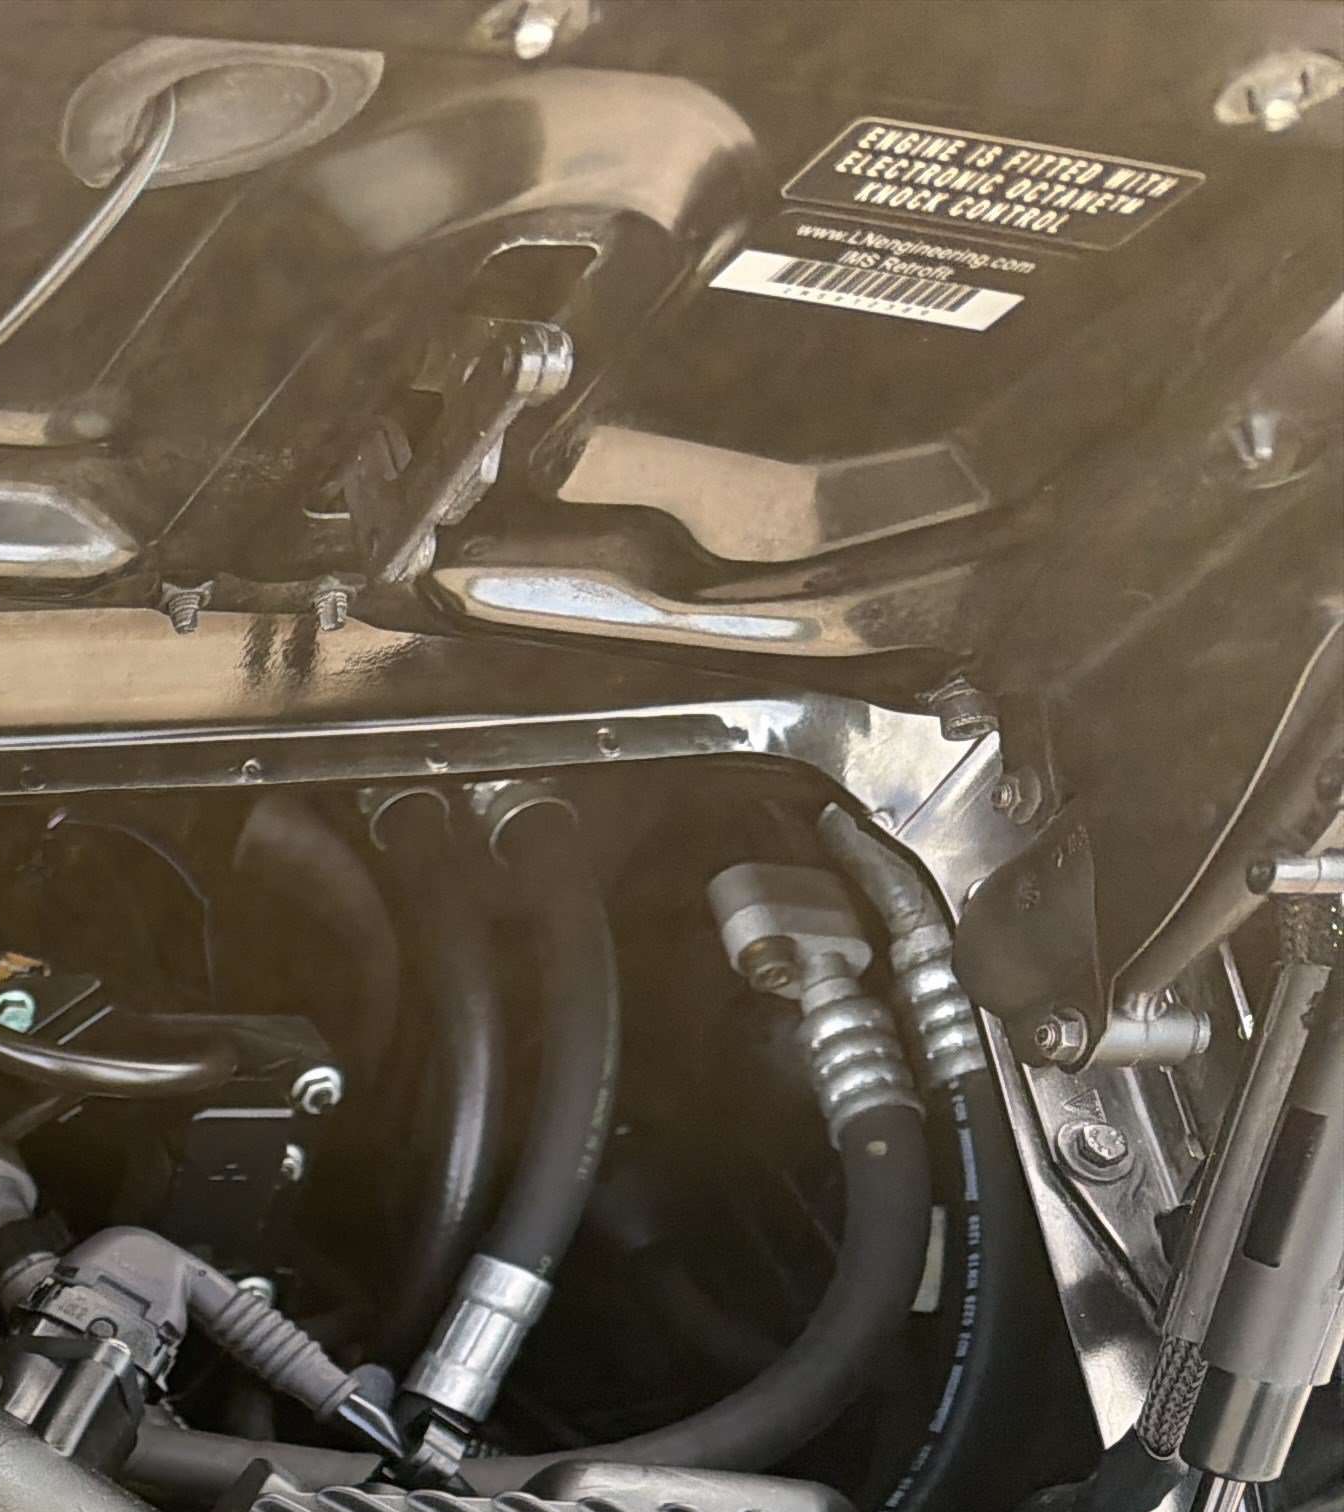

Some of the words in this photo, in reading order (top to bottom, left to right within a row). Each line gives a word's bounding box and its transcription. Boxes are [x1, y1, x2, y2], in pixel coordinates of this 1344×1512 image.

[835, 152, 1005, 194] ELECTRONIC
[858, 127, 966, 162] ENGINE
[965, 144, 1002, 168] IS
[1001, 150, 1103, 184] FITTED
[1104, 168, 1180, 197] WITH
[855, 182, 950, 213] KNOCK
[949, 196, 1072, 234] CONTROL
[796, 221, 1036, 274] www.LNengineering.com
[838, 249, 879, 271] IMS
[877, 254, 956, 281] Retrofit
